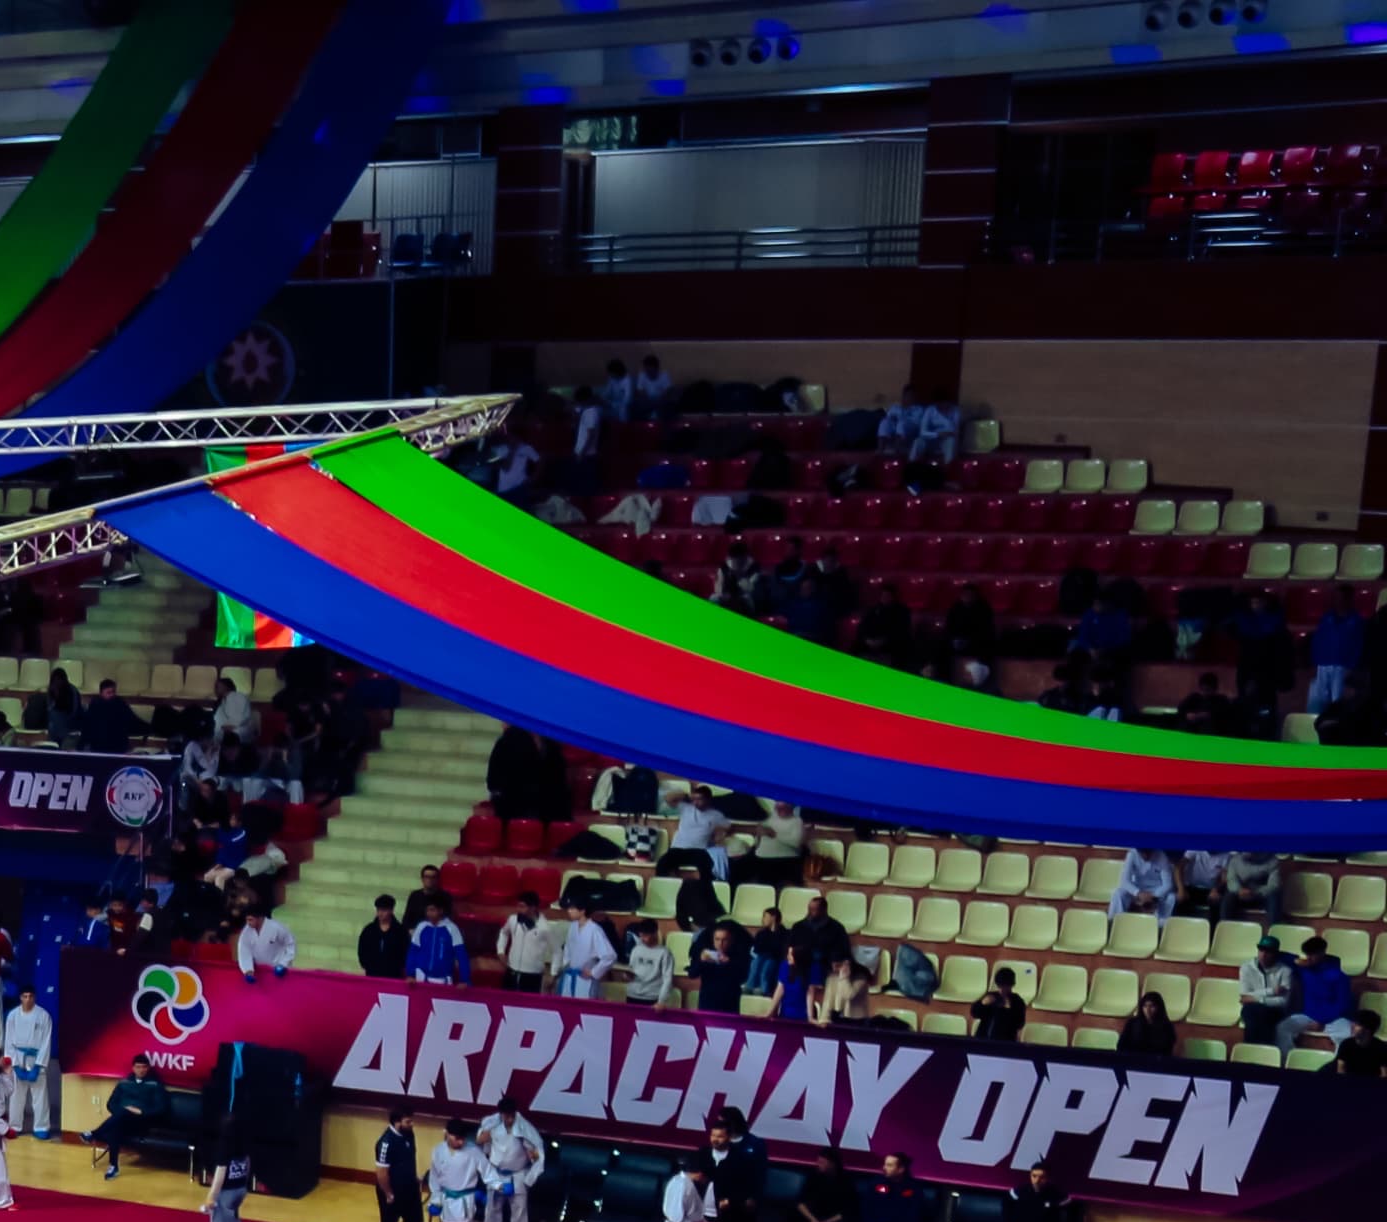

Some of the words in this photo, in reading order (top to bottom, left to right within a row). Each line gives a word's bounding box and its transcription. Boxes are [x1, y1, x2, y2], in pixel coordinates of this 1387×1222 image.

[9, 770, 94, 812] OPEN
[145, 1051, 195, 1072] WKF
[332, 992, 934, 1152] ARPACHAY
[938, 1051, 1281, 1197] OPEN
